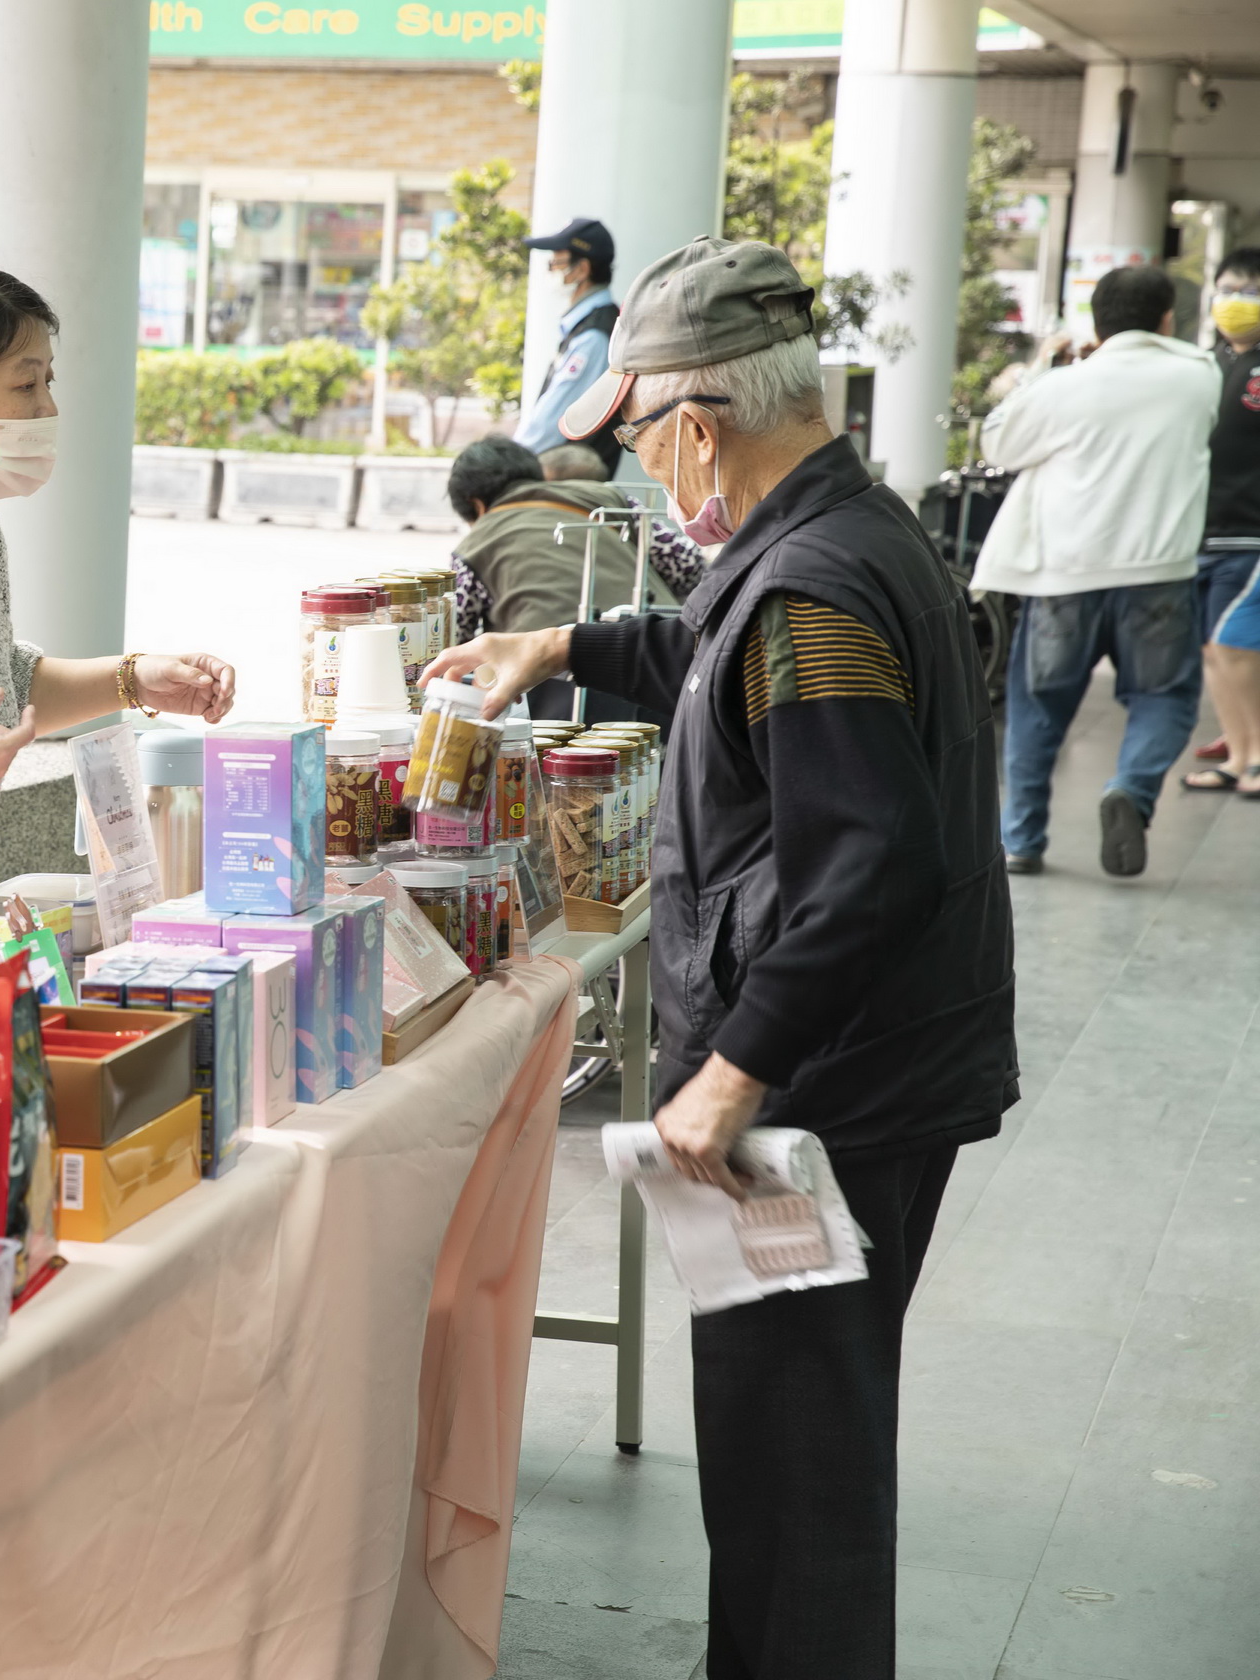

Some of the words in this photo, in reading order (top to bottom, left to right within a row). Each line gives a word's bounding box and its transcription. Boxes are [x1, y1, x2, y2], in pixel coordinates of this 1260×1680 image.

[149, 0, 203, 32] lth
[243, 2, 359, 34] Care
[354, 790, 374, 838] 黑糖
[476, 911, 493, 958] 黑糖
